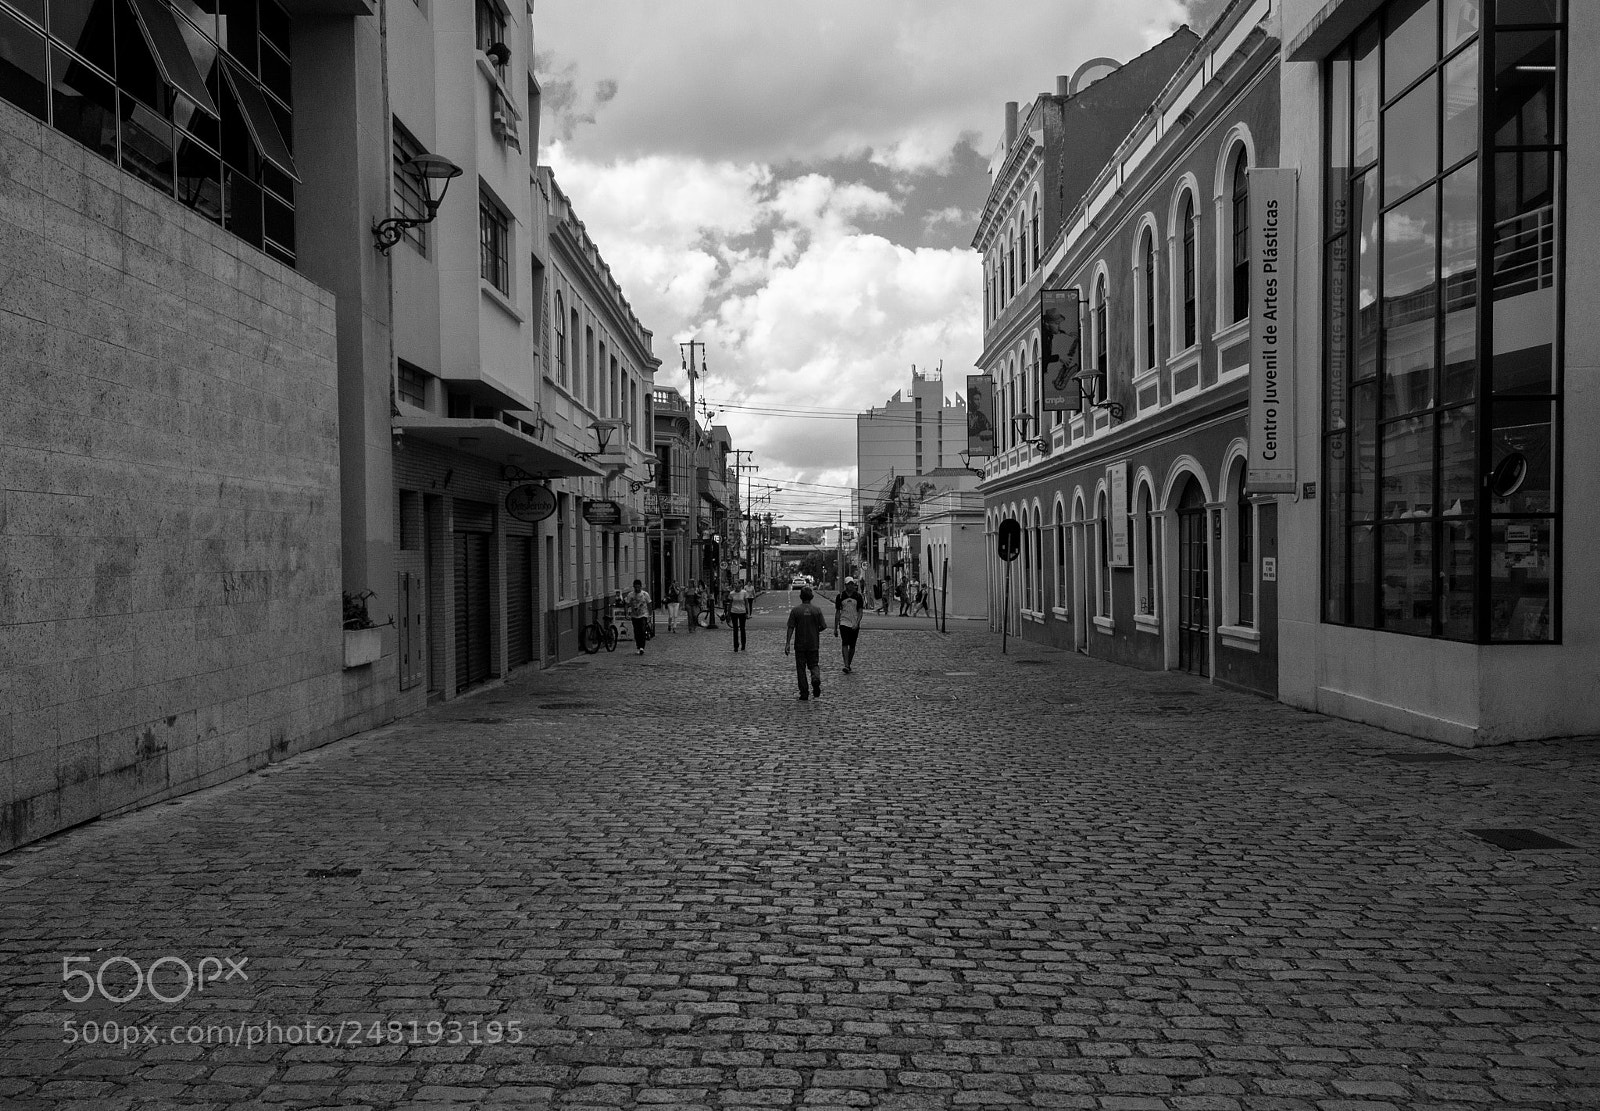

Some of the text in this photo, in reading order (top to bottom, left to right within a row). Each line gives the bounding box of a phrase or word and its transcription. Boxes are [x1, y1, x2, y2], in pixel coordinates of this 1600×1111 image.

[1263, 199, 1278, 273] Plásticas
[1263, 278, 1277, 321] Artes
[1263, 325, 1277, 345] de
[1263, 349, 1279, 404] Juvenil
[1263, 409, 1277, 461] Centro
